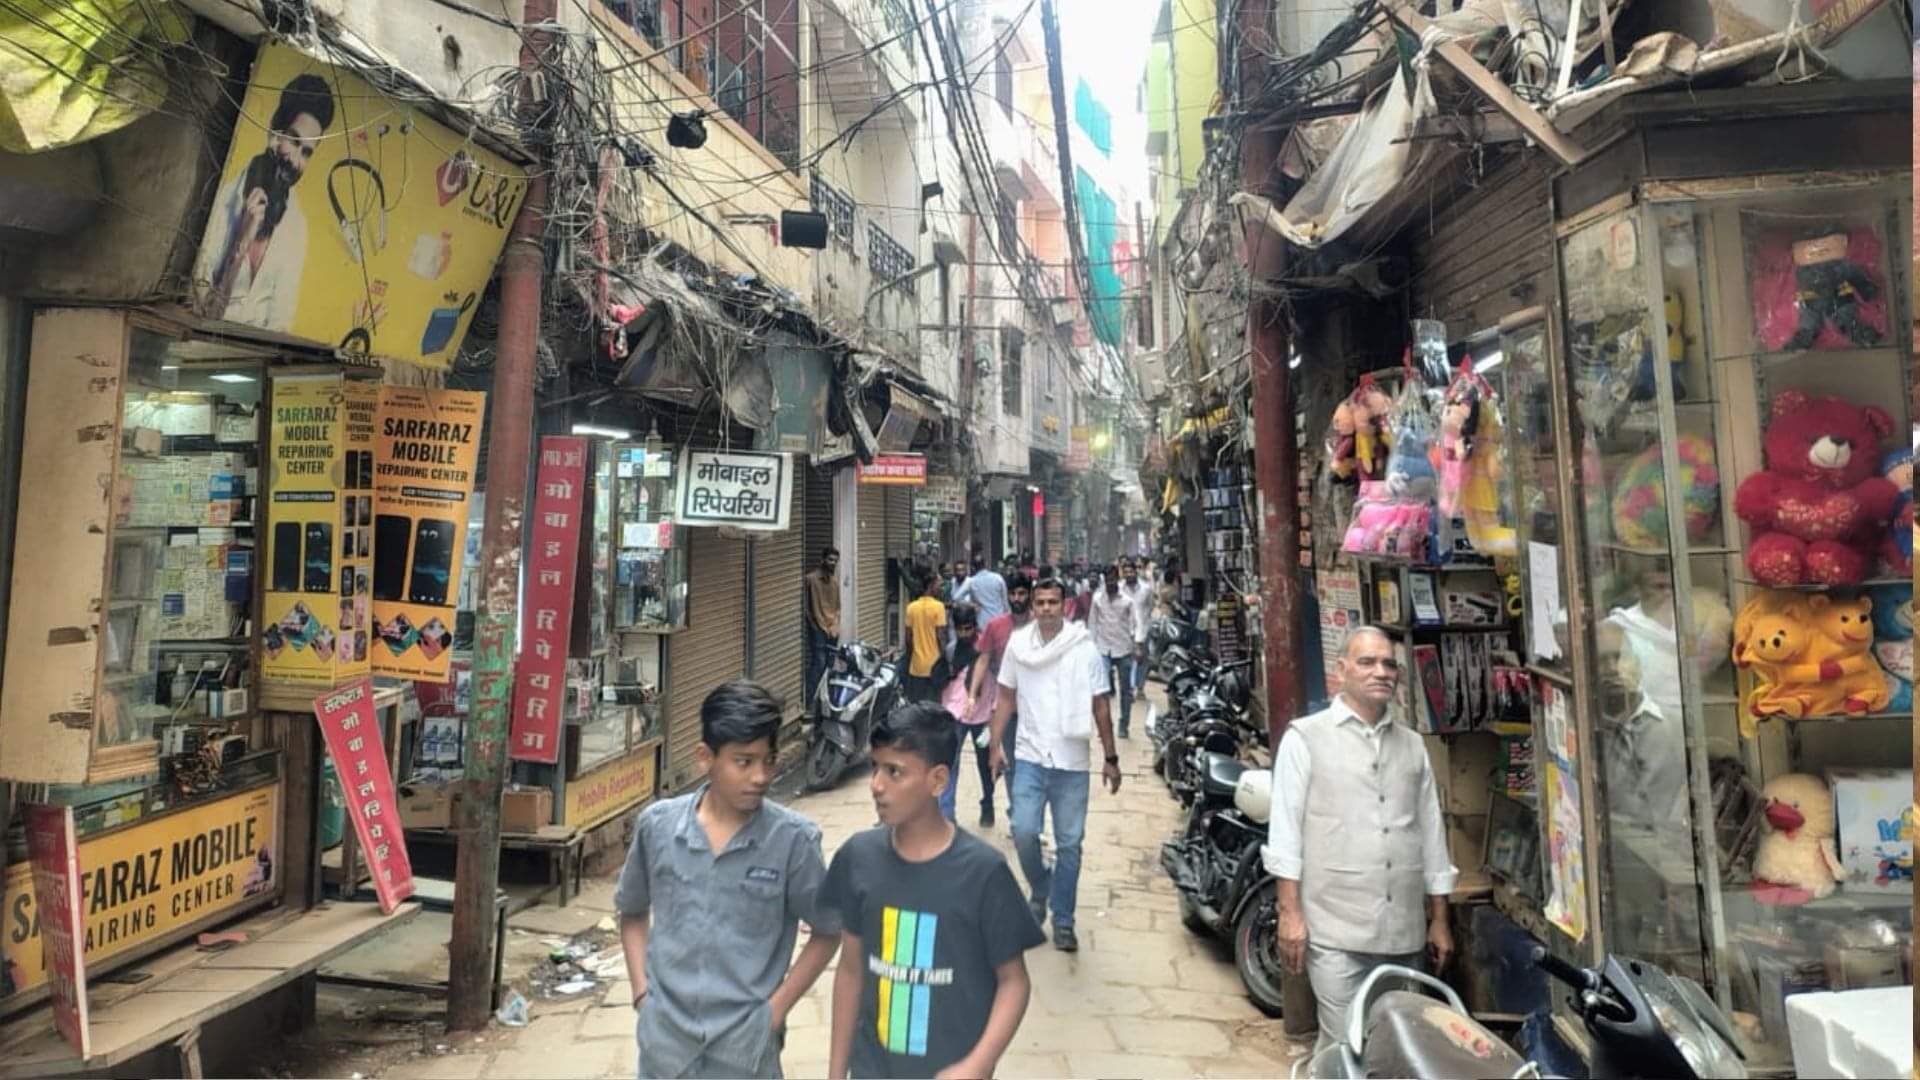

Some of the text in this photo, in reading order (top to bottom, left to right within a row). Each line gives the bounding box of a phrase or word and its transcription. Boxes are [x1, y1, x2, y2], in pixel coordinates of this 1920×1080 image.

[277, 406, 338, 423] SARFARAZ
[284, 425, 329, 441] MOBILE
[384, 417, 472, 443] SARFARAZ
[278, 444, 334, 459] REPAIRING
[392, 441, 457, 465] MOBILE
[286, 461, 325, 475] CENTER
[376, 464, 468, 482] REPAIRING CENTER
[171, 816, 257, 885] MOBILE
[172, 873, 234, 917] CENTER
